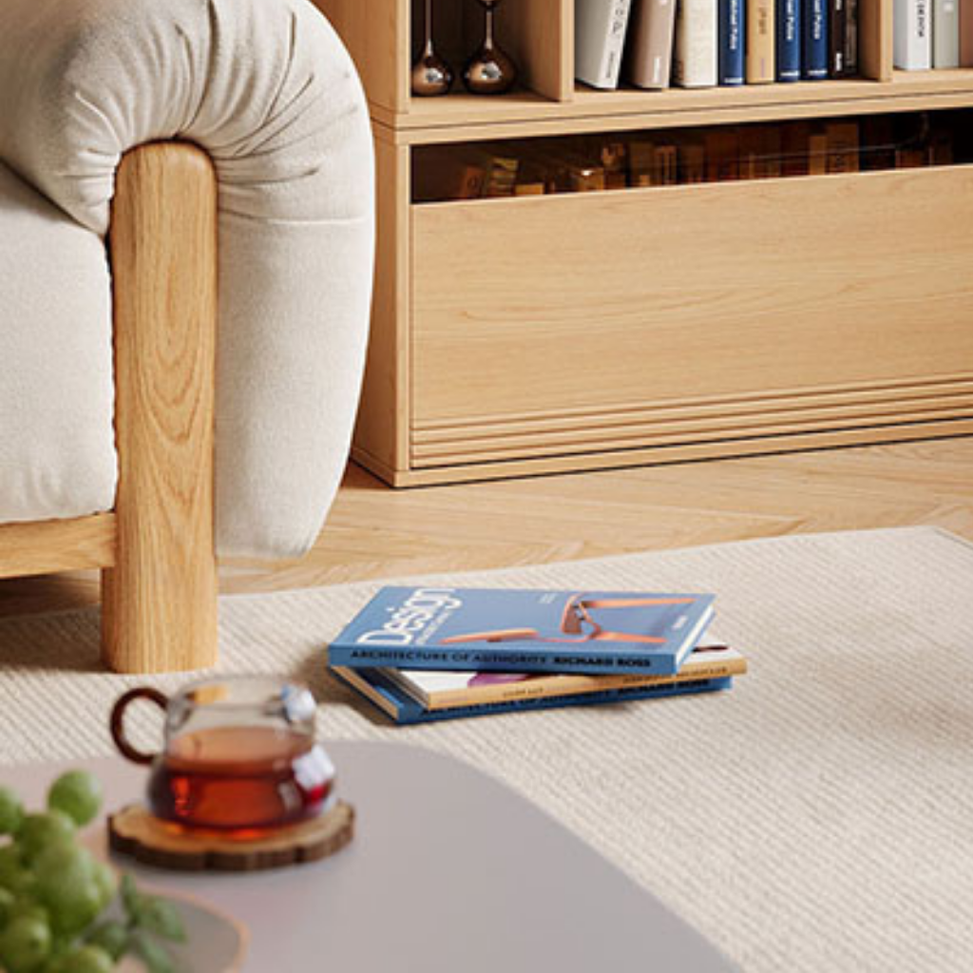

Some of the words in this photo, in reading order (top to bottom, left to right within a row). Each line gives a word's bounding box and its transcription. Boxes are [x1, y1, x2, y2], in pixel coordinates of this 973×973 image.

[356, 588, 462, 645] Design
[351, 649, 448, 661] ARCHITECTURE
[452, 652, 469, 662] OF
[472, 653, 546, 664] AUTHORITY
[554, 656, 613, 667] RICHARD
[617, 658, 651, 668] ROSS
